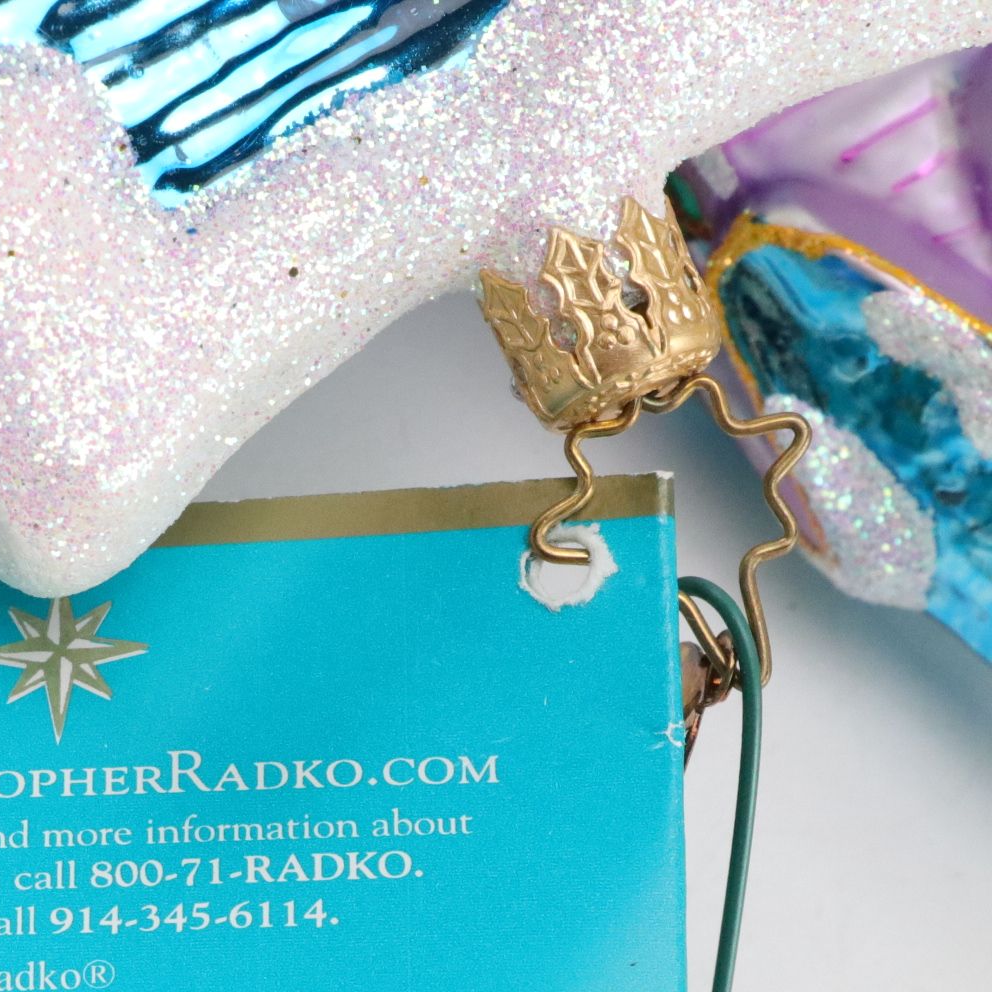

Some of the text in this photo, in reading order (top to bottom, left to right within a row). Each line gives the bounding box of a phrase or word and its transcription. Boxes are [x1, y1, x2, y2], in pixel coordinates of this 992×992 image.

[42, 828, 132, 848] more
[146, 814, 359, 845] information
[372, 807, 473, 837] about
[14, 860, 77, 891] call
[90, 850, 424, 889] 800-71-RADKO.
[49, 898, 339, 935] 914-345-6114.
